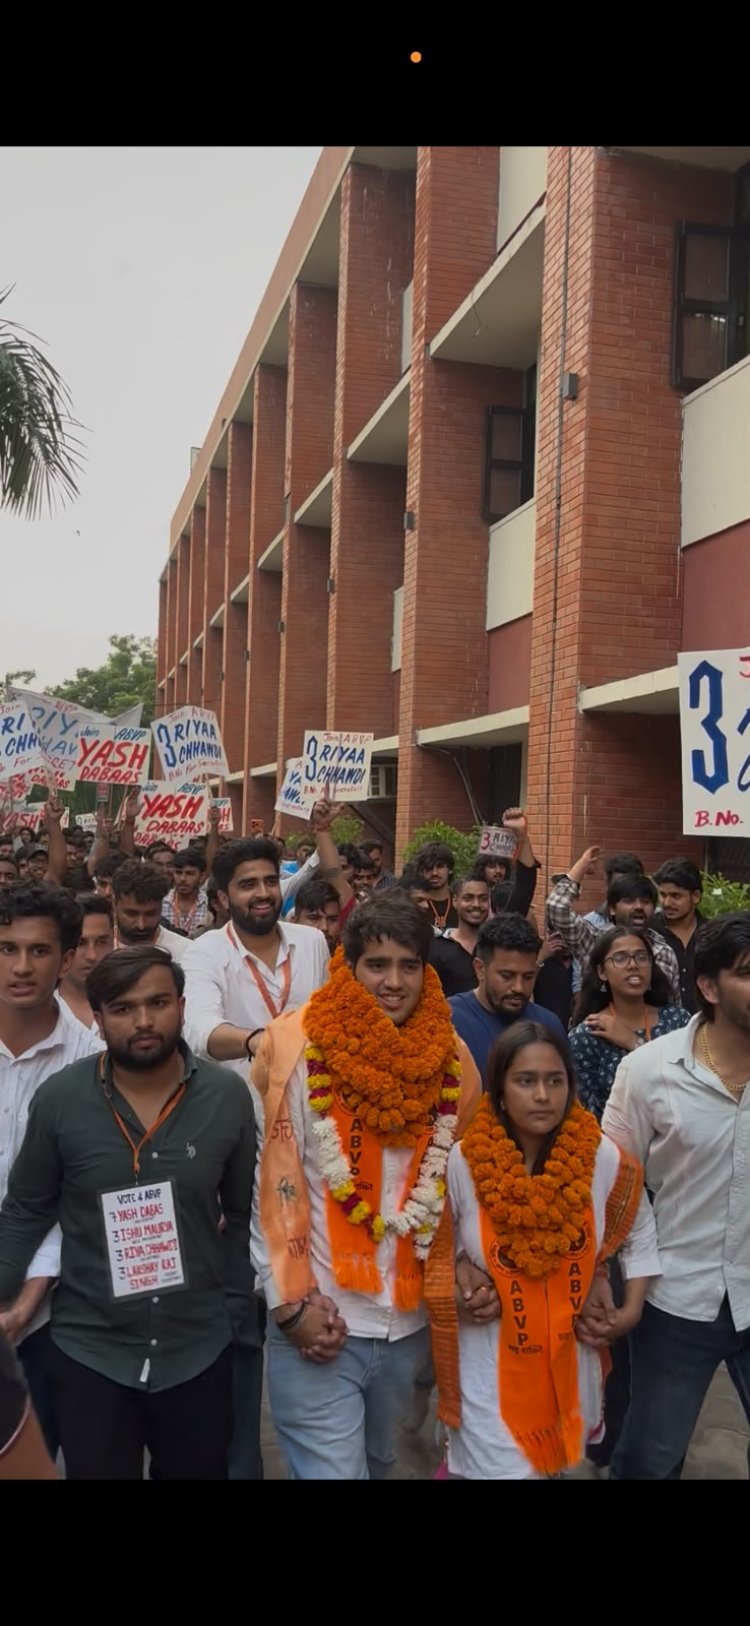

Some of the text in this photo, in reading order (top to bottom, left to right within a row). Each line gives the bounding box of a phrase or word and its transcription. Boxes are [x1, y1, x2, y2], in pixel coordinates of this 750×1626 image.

[114, 728, 147, 741] ABVP
[174, 719, 217, 743] RIYAA
[688, 659, 729, 794] 3
[77, 738, 149, 770] YASH
[157, 723, 177, 768] 3
[319, 744, 365, 765] RIYAA
[305, 735, 318, 782] 3
[80, 766, 143, 784] DABAAS
[141, 794, 204, 820] YASH
[146, 820, 204, 834] DABAAS
[480, 831, 491, 850] 3
[117, 1192, 136, 1205] VOTE
[138, 1193, 143, 1201] 4
[109, 1212, 117, 1223] 7
[117, 1207, 138, 1223] YASH
[112, 1230, 120, 1243] 3
[120, 1227, 142, 1242] ISHU
[115, 1249, 123, 1262] 3
[118, 1266, 126, 1280] 3
[161, 1257, 176, 1270] RAJ
[510, 1279, 529, 1346] ABVP
